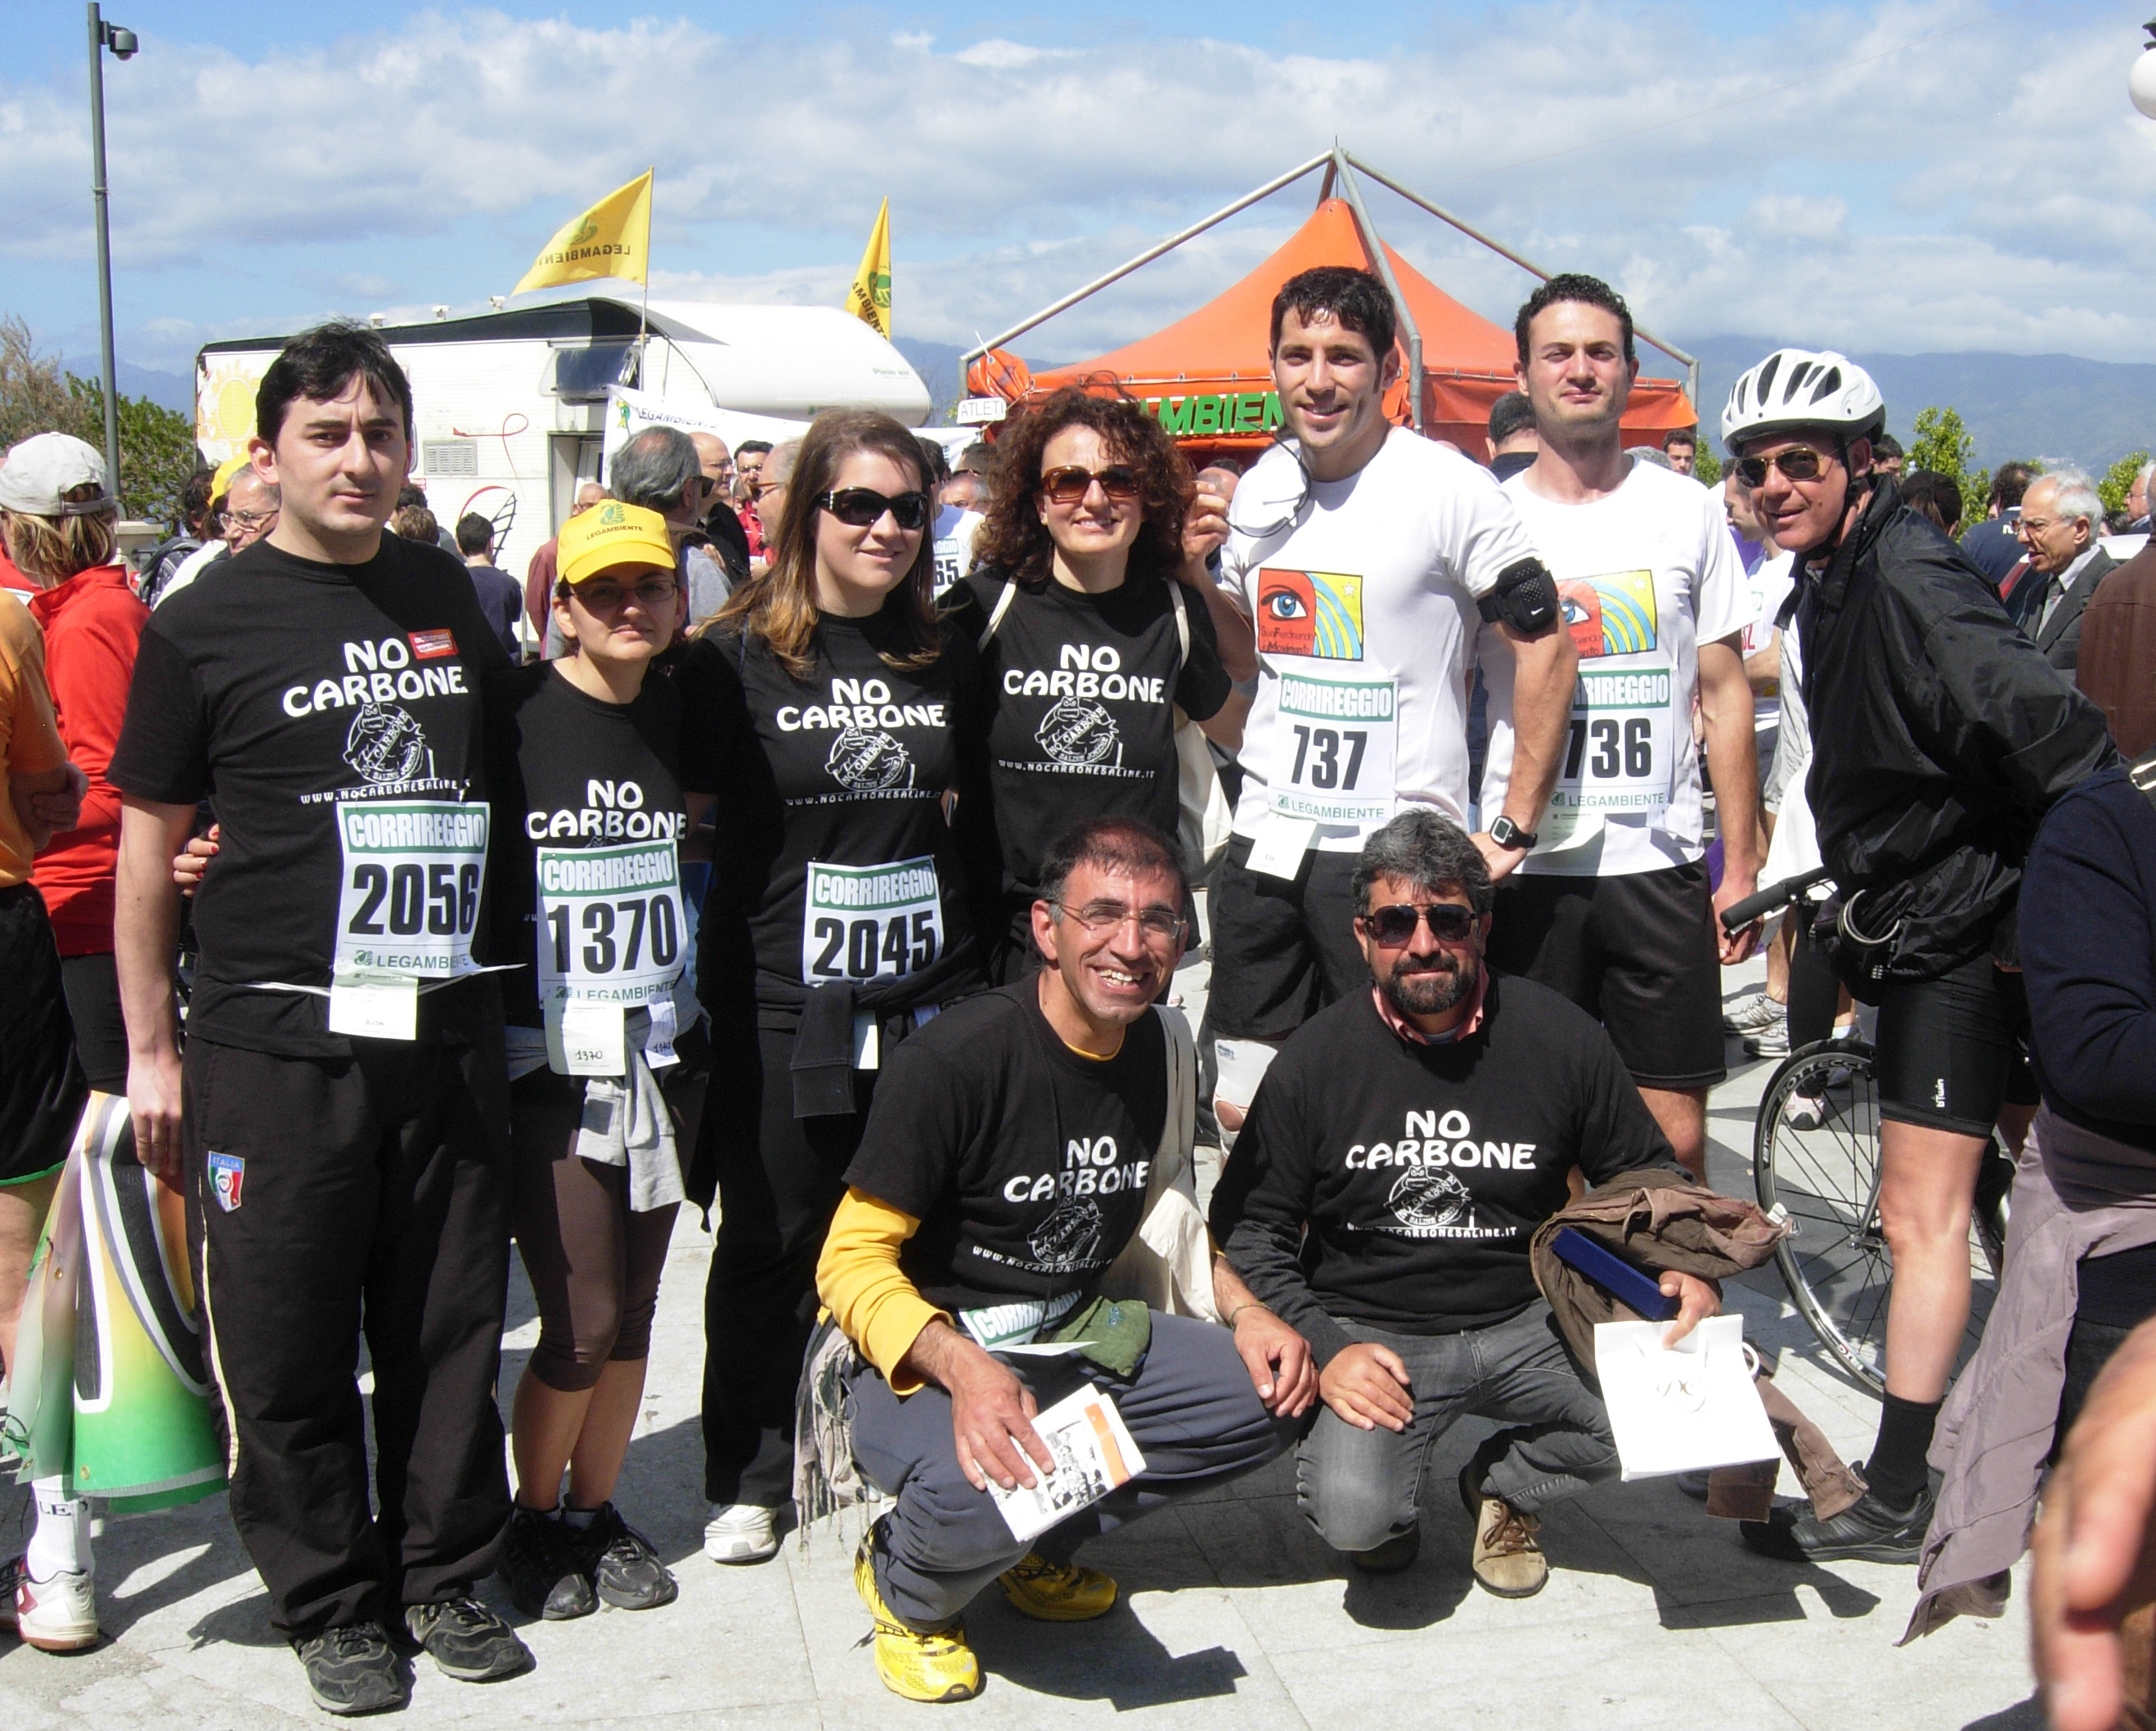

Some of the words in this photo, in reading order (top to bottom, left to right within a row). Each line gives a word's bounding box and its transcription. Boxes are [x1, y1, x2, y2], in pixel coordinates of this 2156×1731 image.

[960, 399, 1005, 417] ATLETI
[586, 525, 644, 541] LEGAMBIENTE
[344, 638, 409, 672] NO
[1061, 645, 1120, 672] NO
[283, 666, 469, 717] CARBONE
[832, 678, 891, 704] NO
[1004, 670, 1165, 704] CARBONE
[1282, 678, 1393, 717] CORRIREGGIO
[375, 709, 409, 758] CARBONE
[777, 704, 946, 731] CARBONE
[1063, 706, 1106, 743] CARBONE
[855, 732, 891, 770] CARBONE
[1291, 724, 1368, 791] 737
[1564, 717, 1652, 779] 736
[588, 780, 644, 809] NO
[1292, 800, 1385, 819] LEGAMBIENTE
[1569, 792, 1664, 807] LEGAMBIENTE
[348, 813, 485, 848] CORRIREGGIO
[526, 809, 687, 840] CARBONE
[543, 851, 674, 892] CORRIREGGIO
[815, 868, 935, 906] CORRIREGGIO
[348, 864, 480, 936] 2056
[547, 894, 678, 974] 1370
[813, 910, 937, 978] 2045
[377, 955, 469, 969] LEGAMBIENTE
[575, 1050, 603, 1060] 1370
[1405, 1110, 1470, 1138] NO
[213, 1157, 239, 1168] ITALIA
[1067, 1136, 1116, 1168] NO
[1345, 1140, 1537, 1170] CARBONE
[1004, 1162, 1150, 1203] CARBONE
